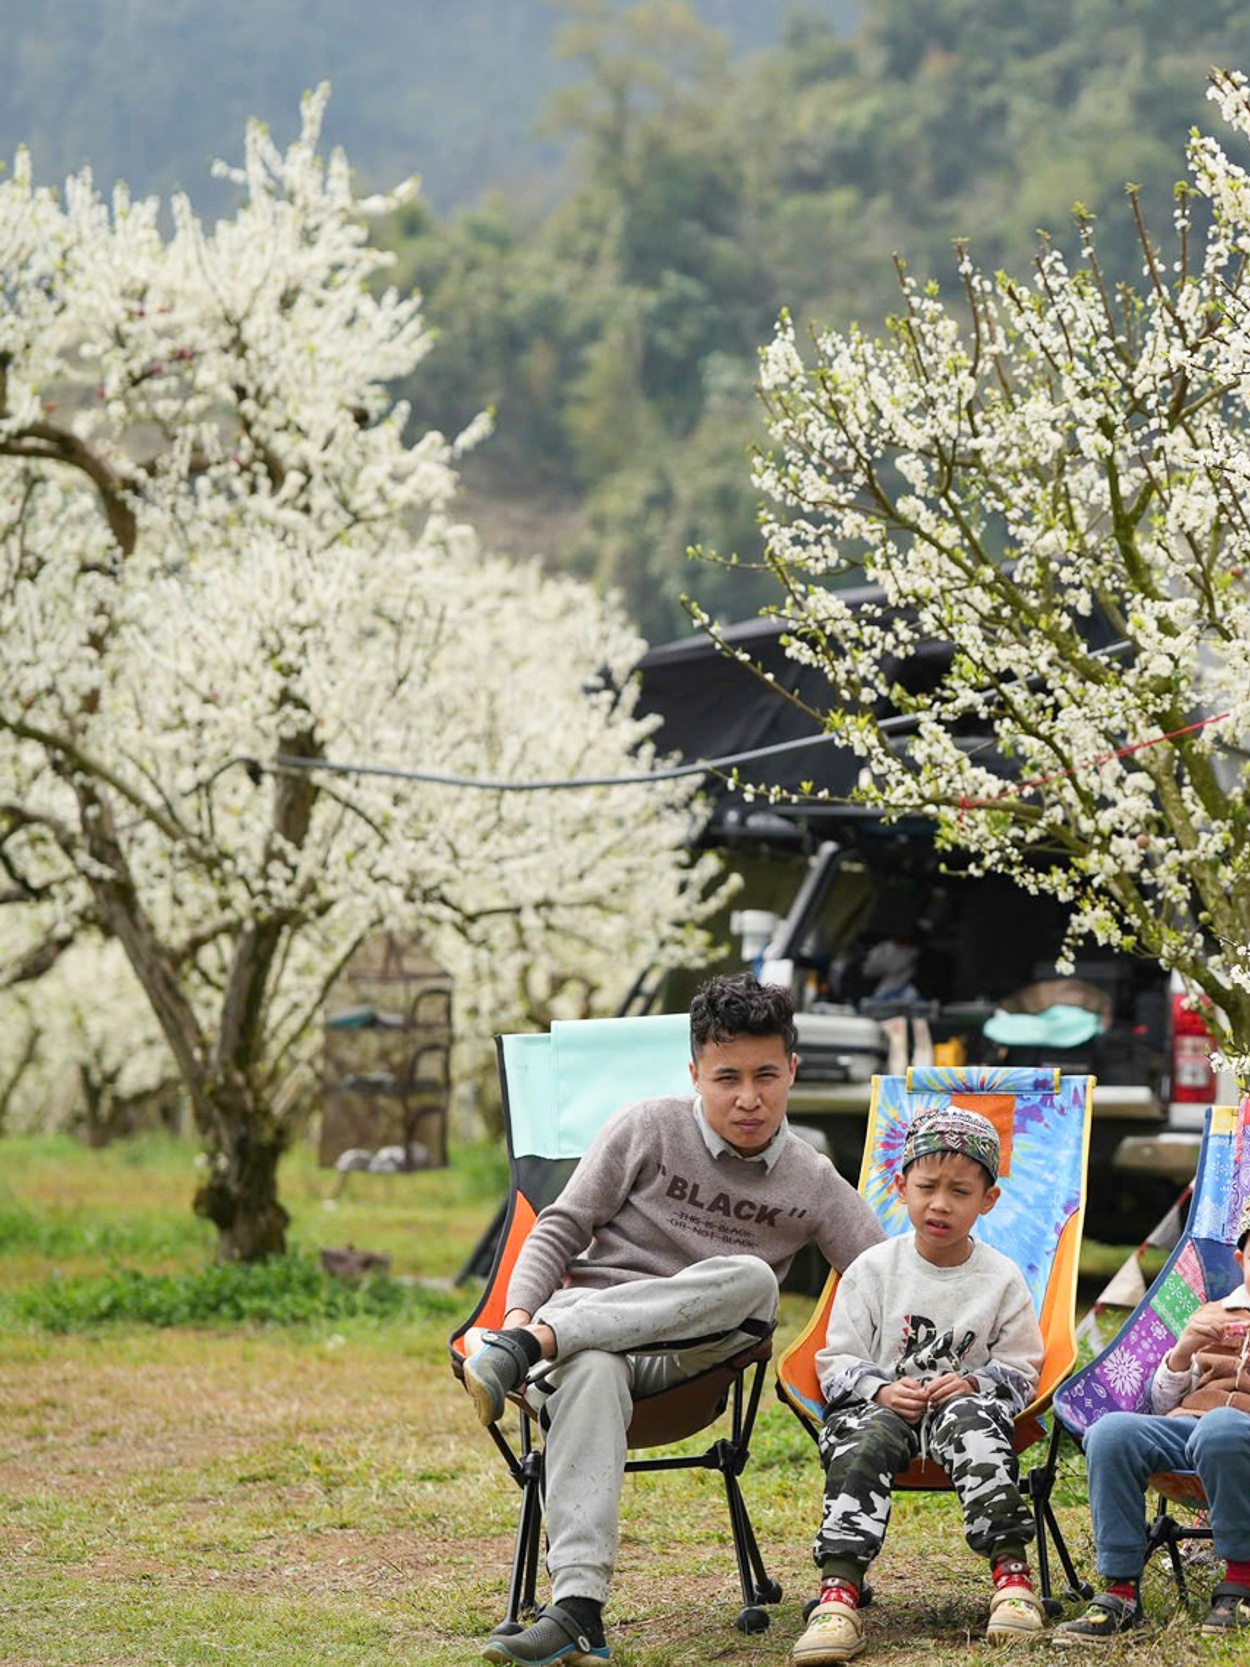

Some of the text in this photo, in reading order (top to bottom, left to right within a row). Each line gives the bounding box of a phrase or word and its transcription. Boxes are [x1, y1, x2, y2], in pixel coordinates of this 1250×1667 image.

[670, 1218, 755, 1249] OR NOT BLACK
[718, 1224, 751, 1238] BLACK
